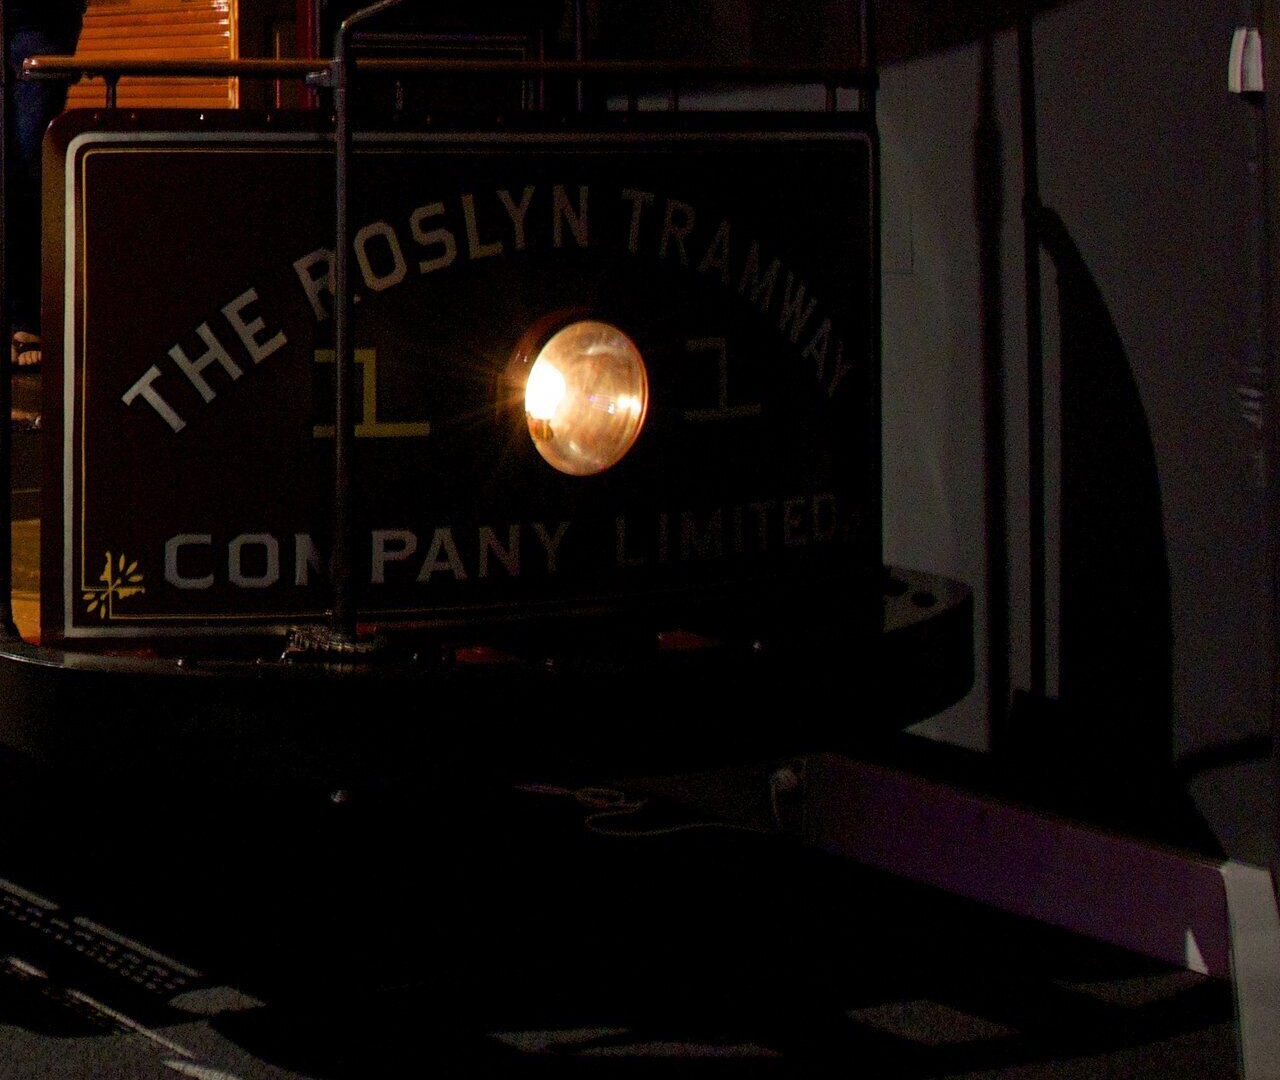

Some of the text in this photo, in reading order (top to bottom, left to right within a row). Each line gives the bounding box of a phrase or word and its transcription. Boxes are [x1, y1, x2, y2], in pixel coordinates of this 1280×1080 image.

[121, 183, 857, 435] THE ROSLYN TRAMWAY
[312, 347, 431, 439] 1
[684, 335, 762, 422] 1
